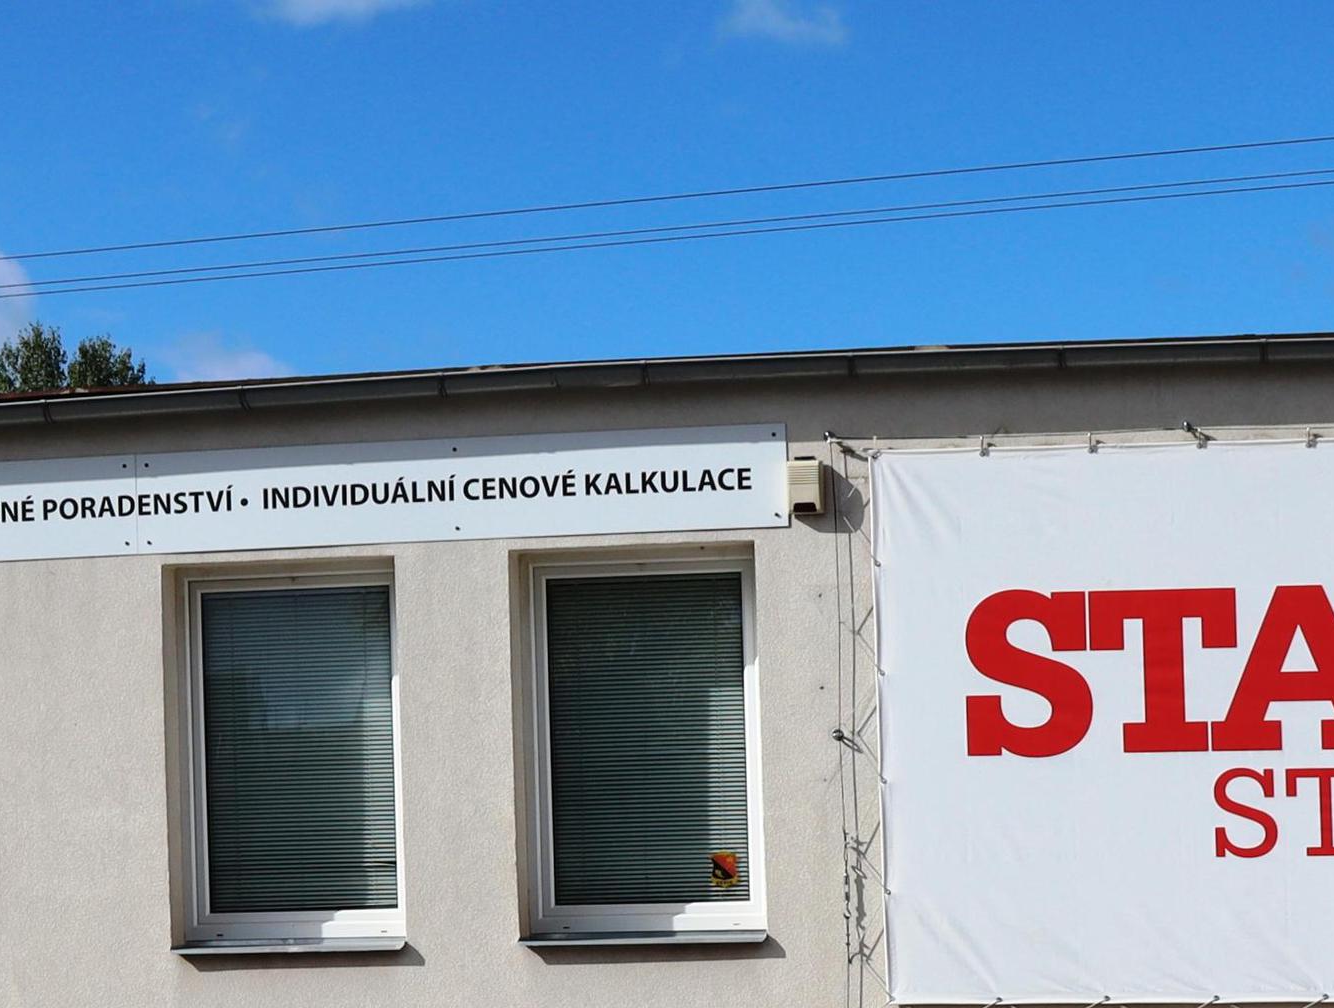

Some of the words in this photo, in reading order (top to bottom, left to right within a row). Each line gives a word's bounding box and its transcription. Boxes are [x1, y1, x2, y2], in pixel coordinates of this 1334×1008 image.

[42, 484, 233, 523] PORADENSTVÍ
[263, 474, 456, 511] INDIVIDUÁLNÍ
[463, 469, 577, 502] CENOVÉ
[584, 467, 753, 497] KALKULACE
